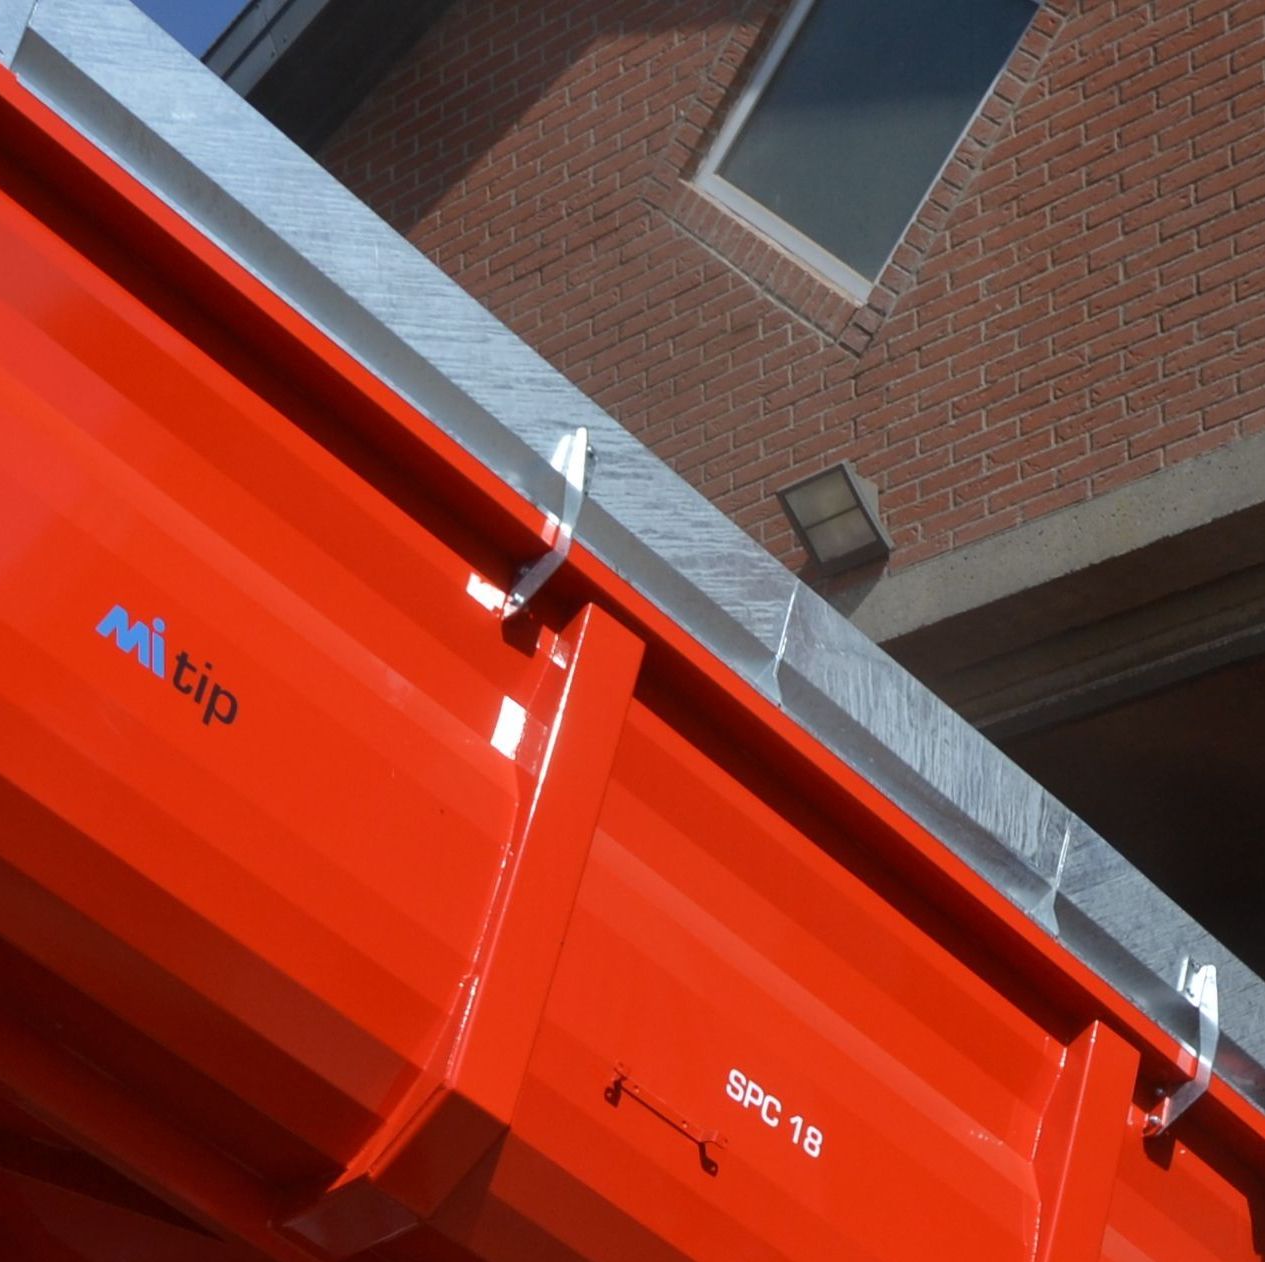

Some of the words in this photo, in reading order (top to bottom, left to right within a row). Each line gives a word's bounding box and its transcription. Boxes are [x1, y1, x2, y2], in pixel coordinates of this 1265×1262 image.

[95, 604, 166, 679] Mi
[172, 651, 239, 726] tip
[725, 1068, 782, 1128] SPC
[789, 1115, 823, 1158] 18
